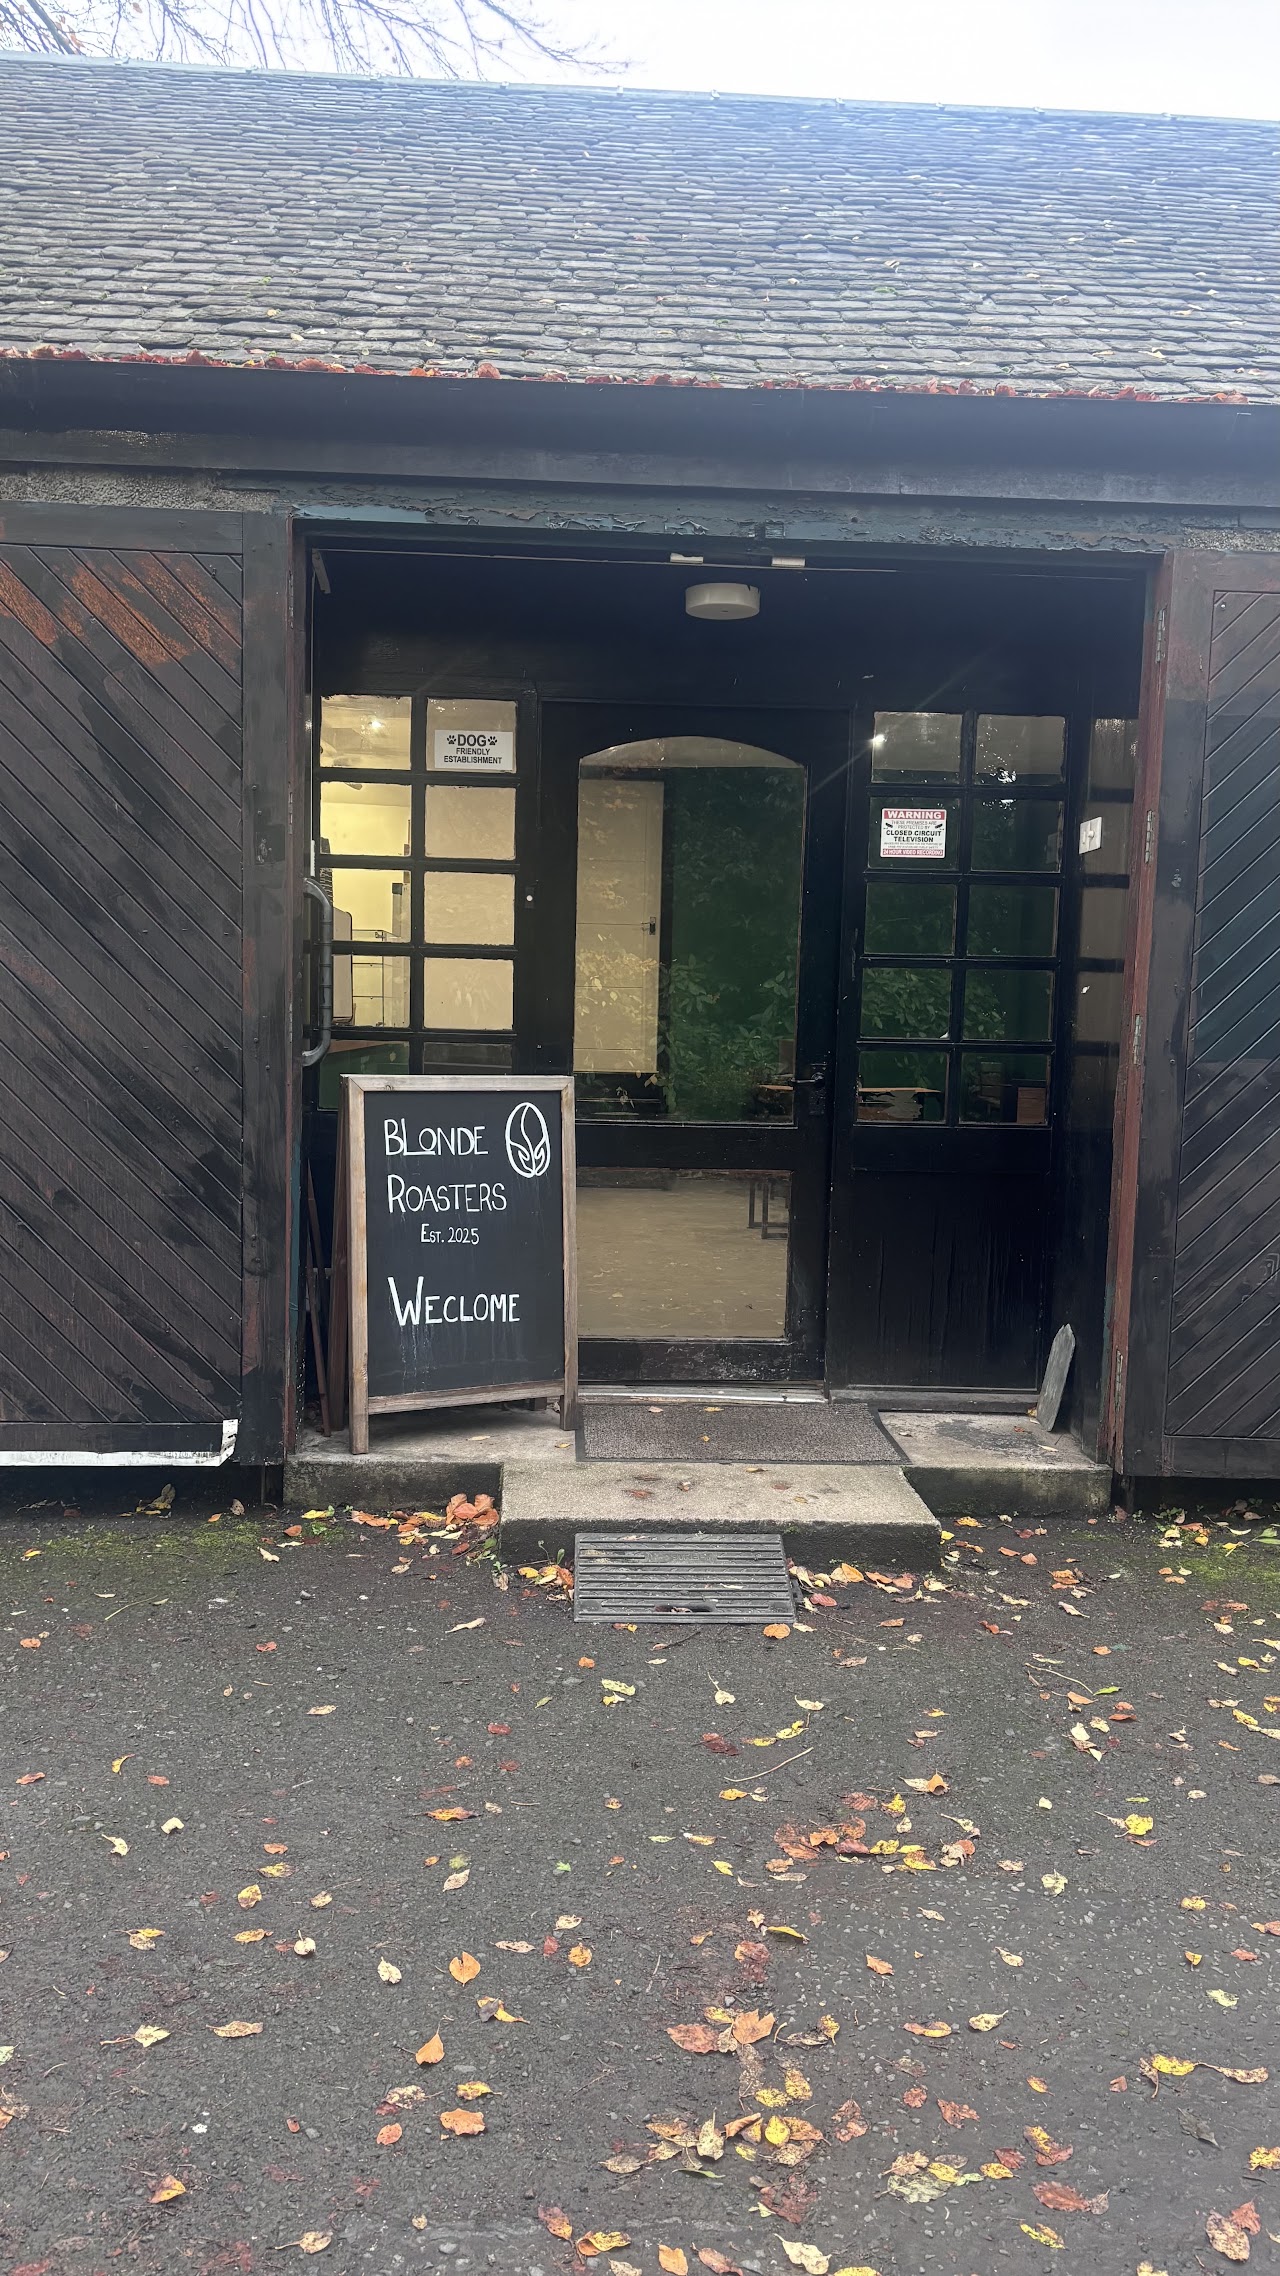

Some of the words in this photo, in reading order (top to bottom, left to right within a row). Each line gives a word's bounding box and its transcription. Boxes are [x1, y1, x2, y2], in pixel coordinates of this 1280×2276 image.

[458, 734, 486, 746] DOG
[444, 756, 502, 764] ESTABLISHMENT
[887, 811, 941, 819] WARNING
[384, 1118, 489, 1156] BLONDE
[387, 1174, 507, 1214] ROASTERS
[448, 1227, 479, 1245] 2025
[387, 1276, 520, 1326] WECLOME
